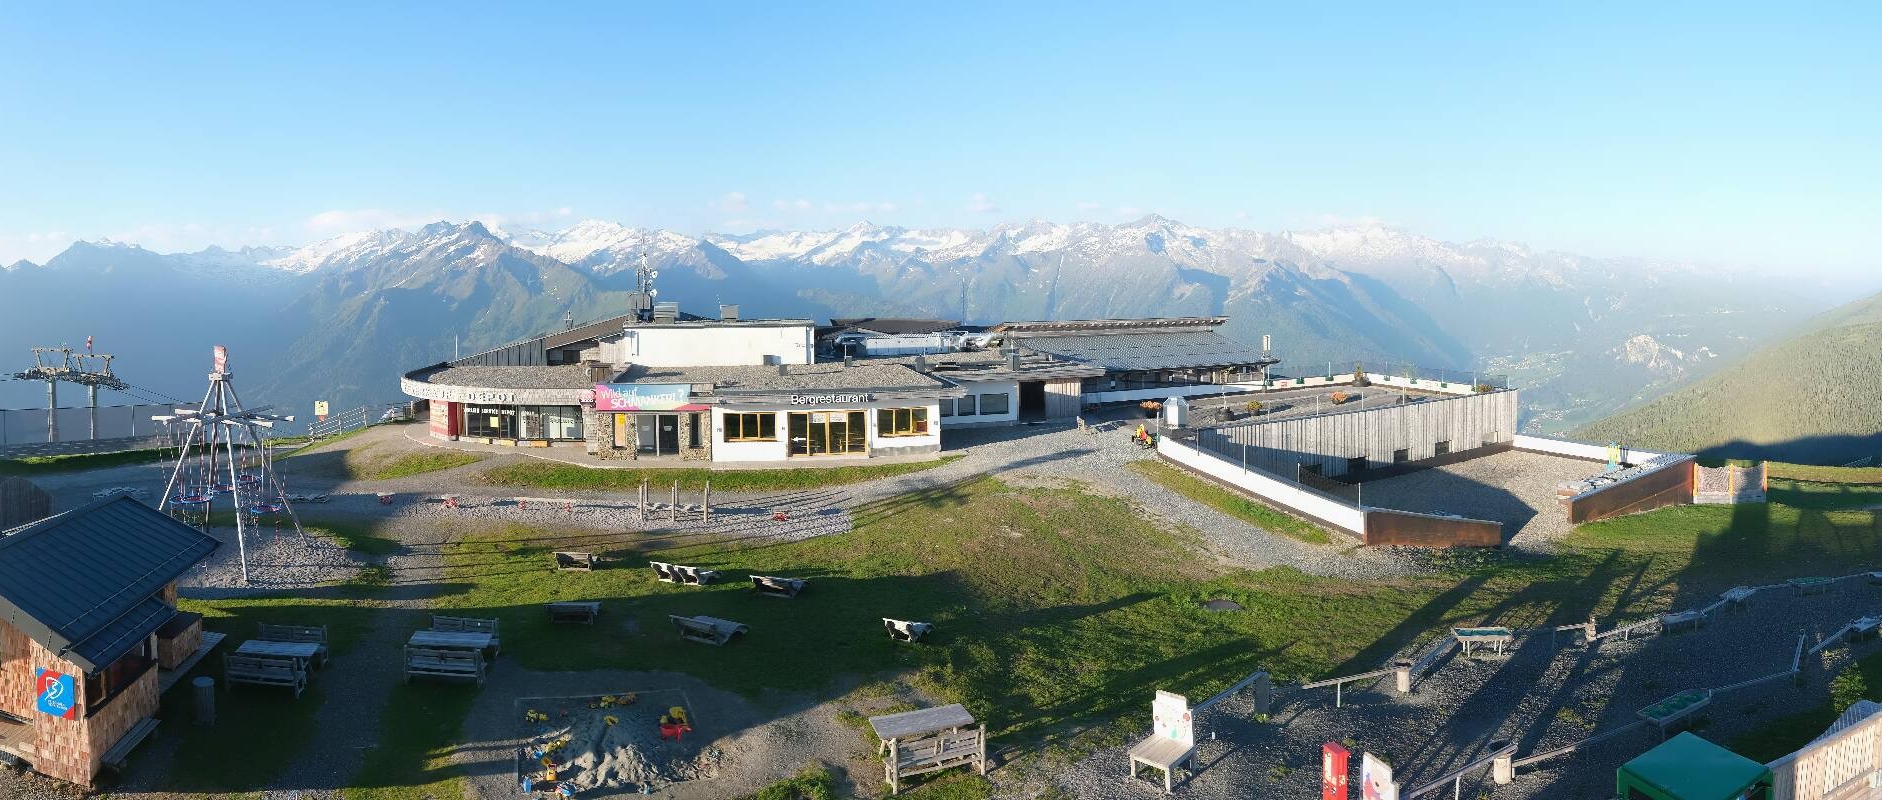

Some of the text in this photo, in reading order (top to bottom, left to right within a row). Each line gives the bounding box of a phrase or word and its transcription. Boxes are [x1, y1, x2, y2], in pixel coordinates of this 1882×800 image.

[601, 387, 621, 399] Wild
[622, 386, 639, 397] auf
[791, 393, 869, 406] Bergrestaurant
